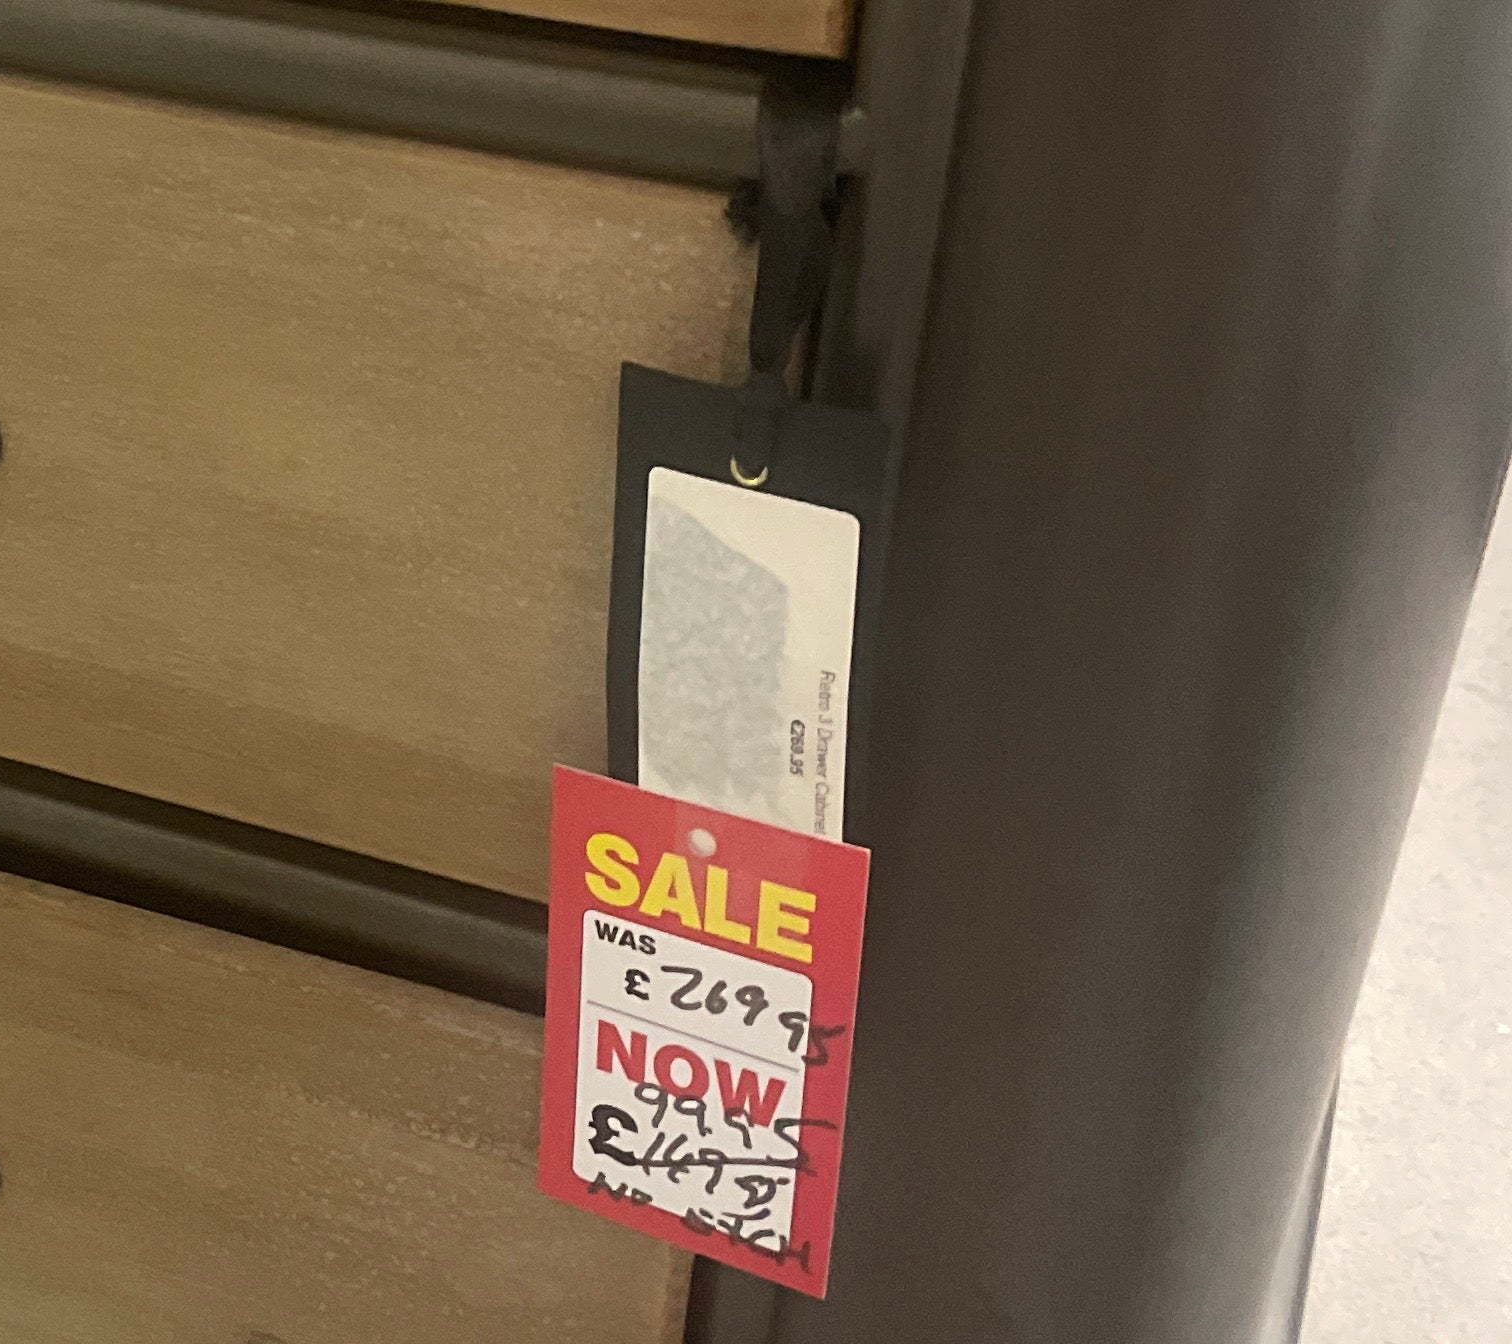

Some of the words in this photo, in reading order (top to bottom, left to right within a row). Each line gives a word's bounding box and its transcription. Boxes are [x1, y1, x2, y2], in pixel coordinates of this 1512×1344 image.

[818, 669, 836, 712] Retro
[817, 727, 833, 778] Drawer
[584, 832, 817, 965] SALE
[594, 919, 657, 955] WAS
[595, 1019, 787, 1128] NOW
